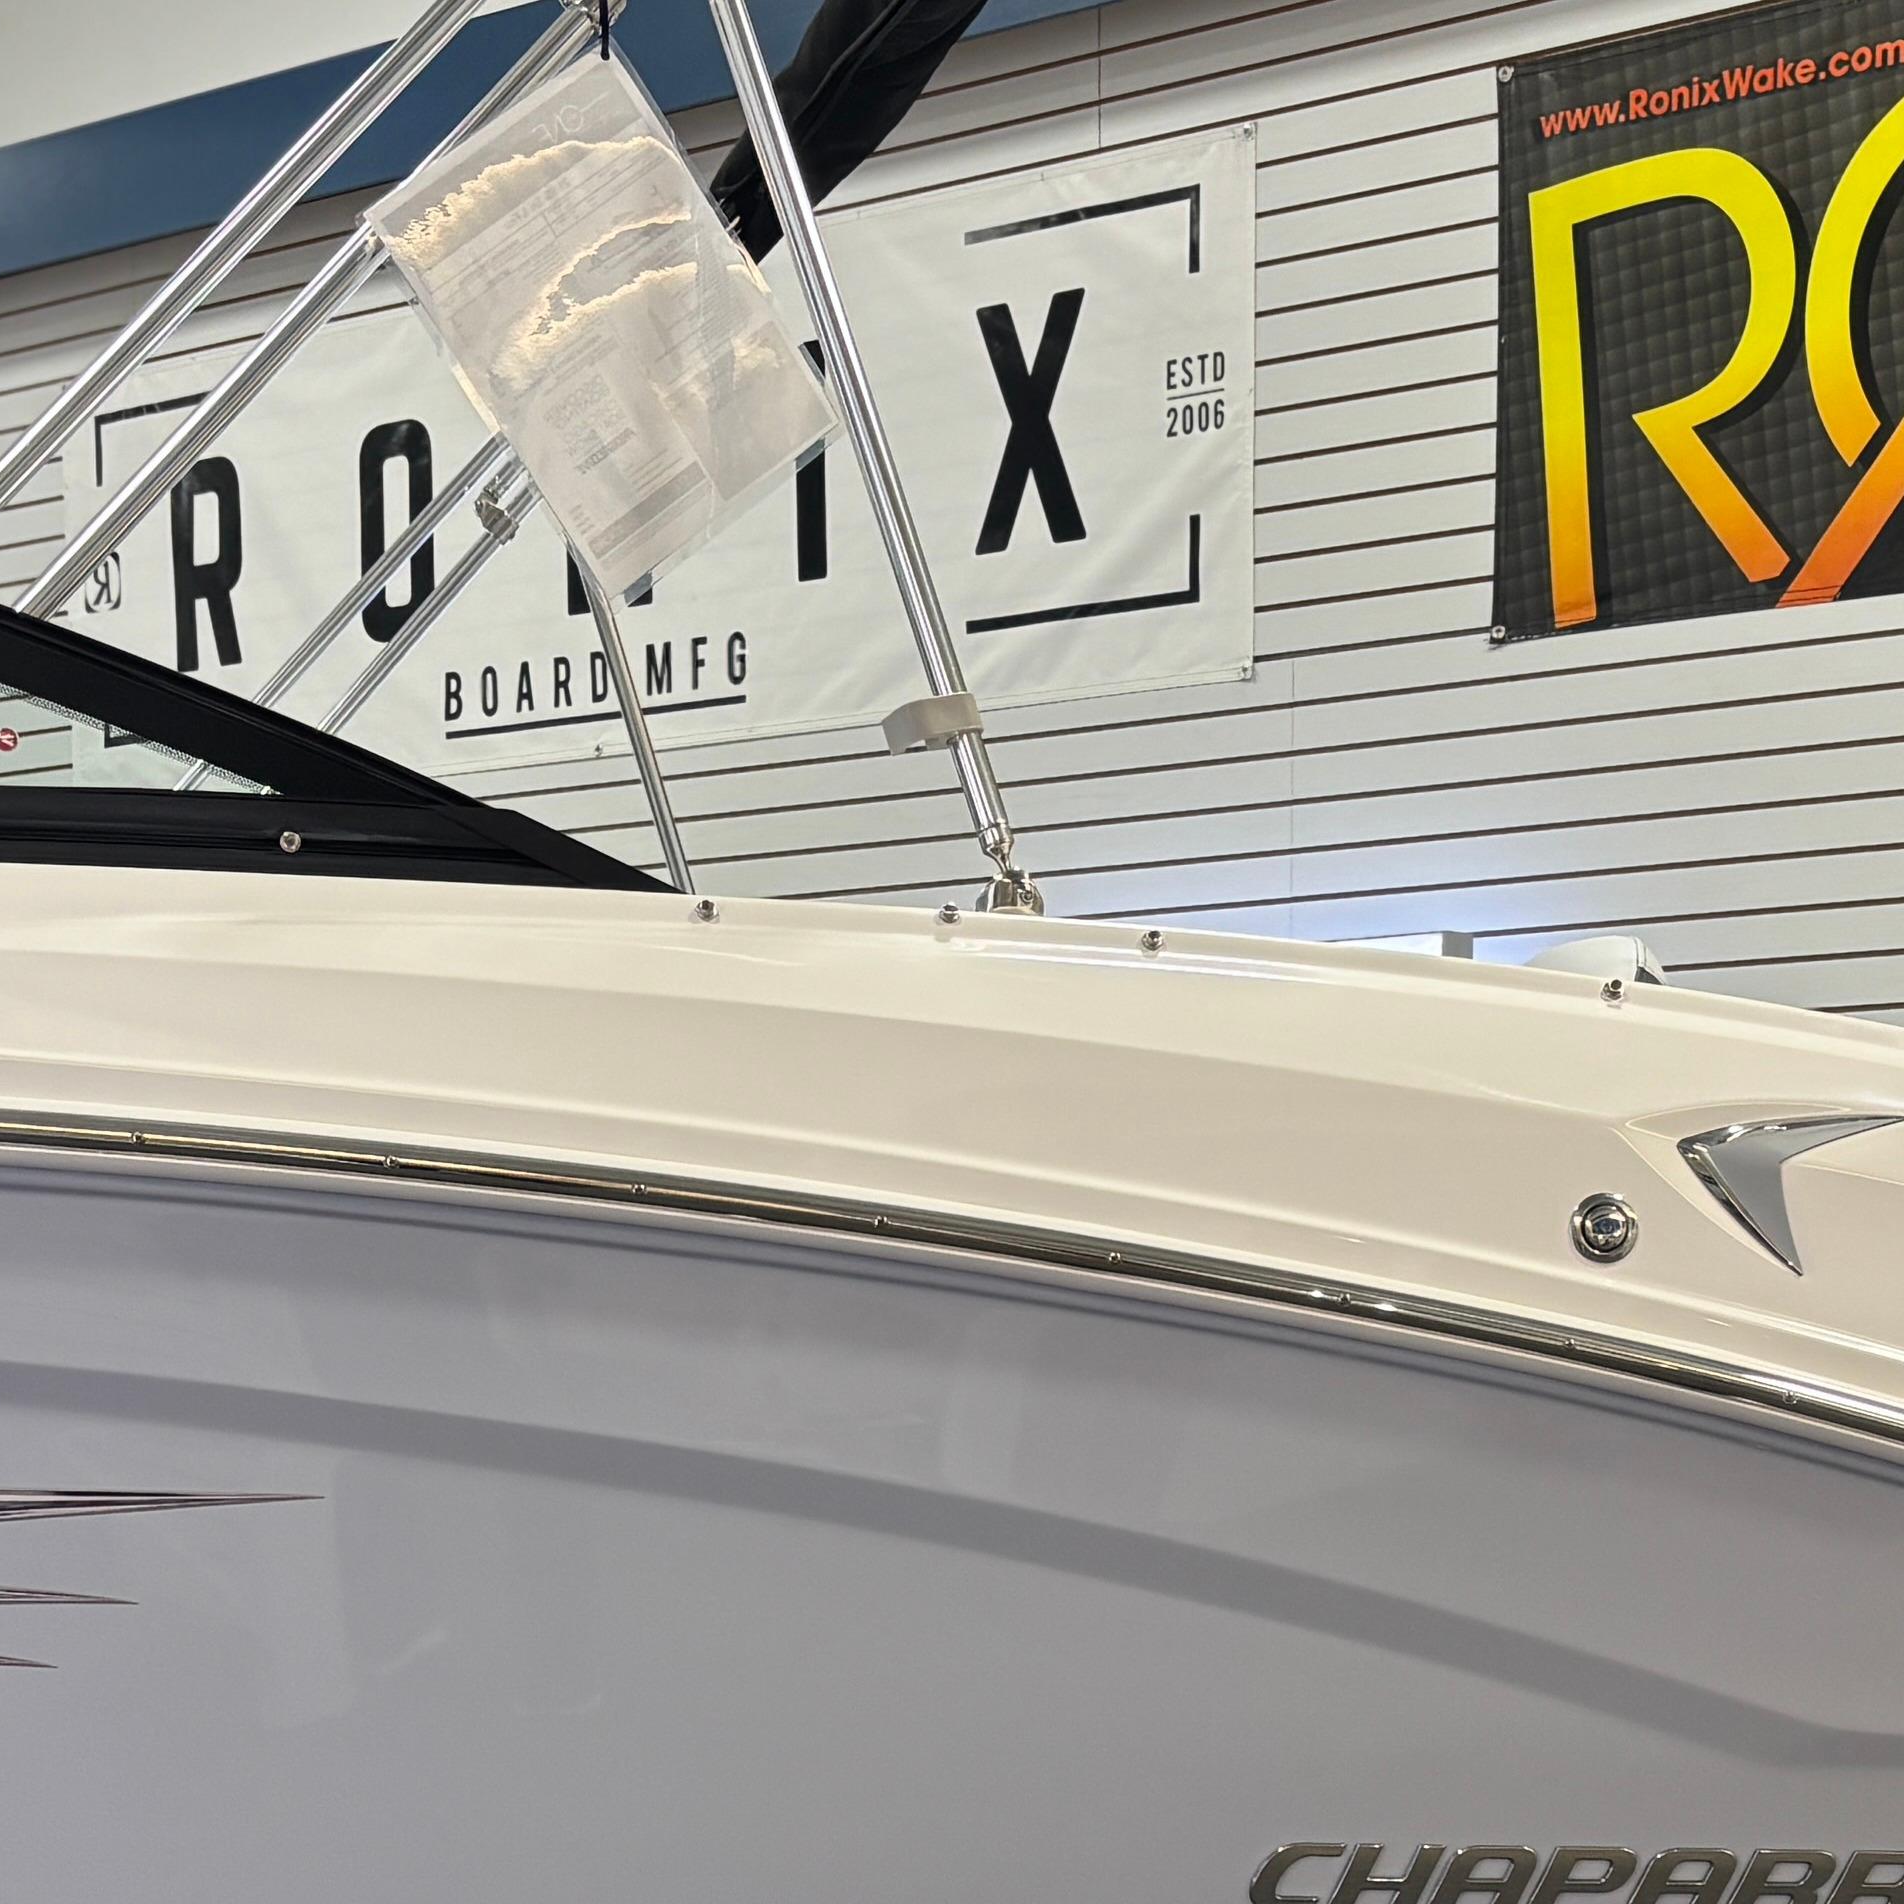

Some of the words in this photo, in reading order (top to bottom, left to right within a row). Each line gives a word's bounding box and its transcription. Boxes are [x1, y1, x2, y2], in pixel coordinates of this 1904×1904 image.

[1166, 351, 1225, 391] ESTD
[1166, 399, 1225, 438] 2006
[444, 653, 609, 723] BOARD
[646, 631, 748, 697] MFG
